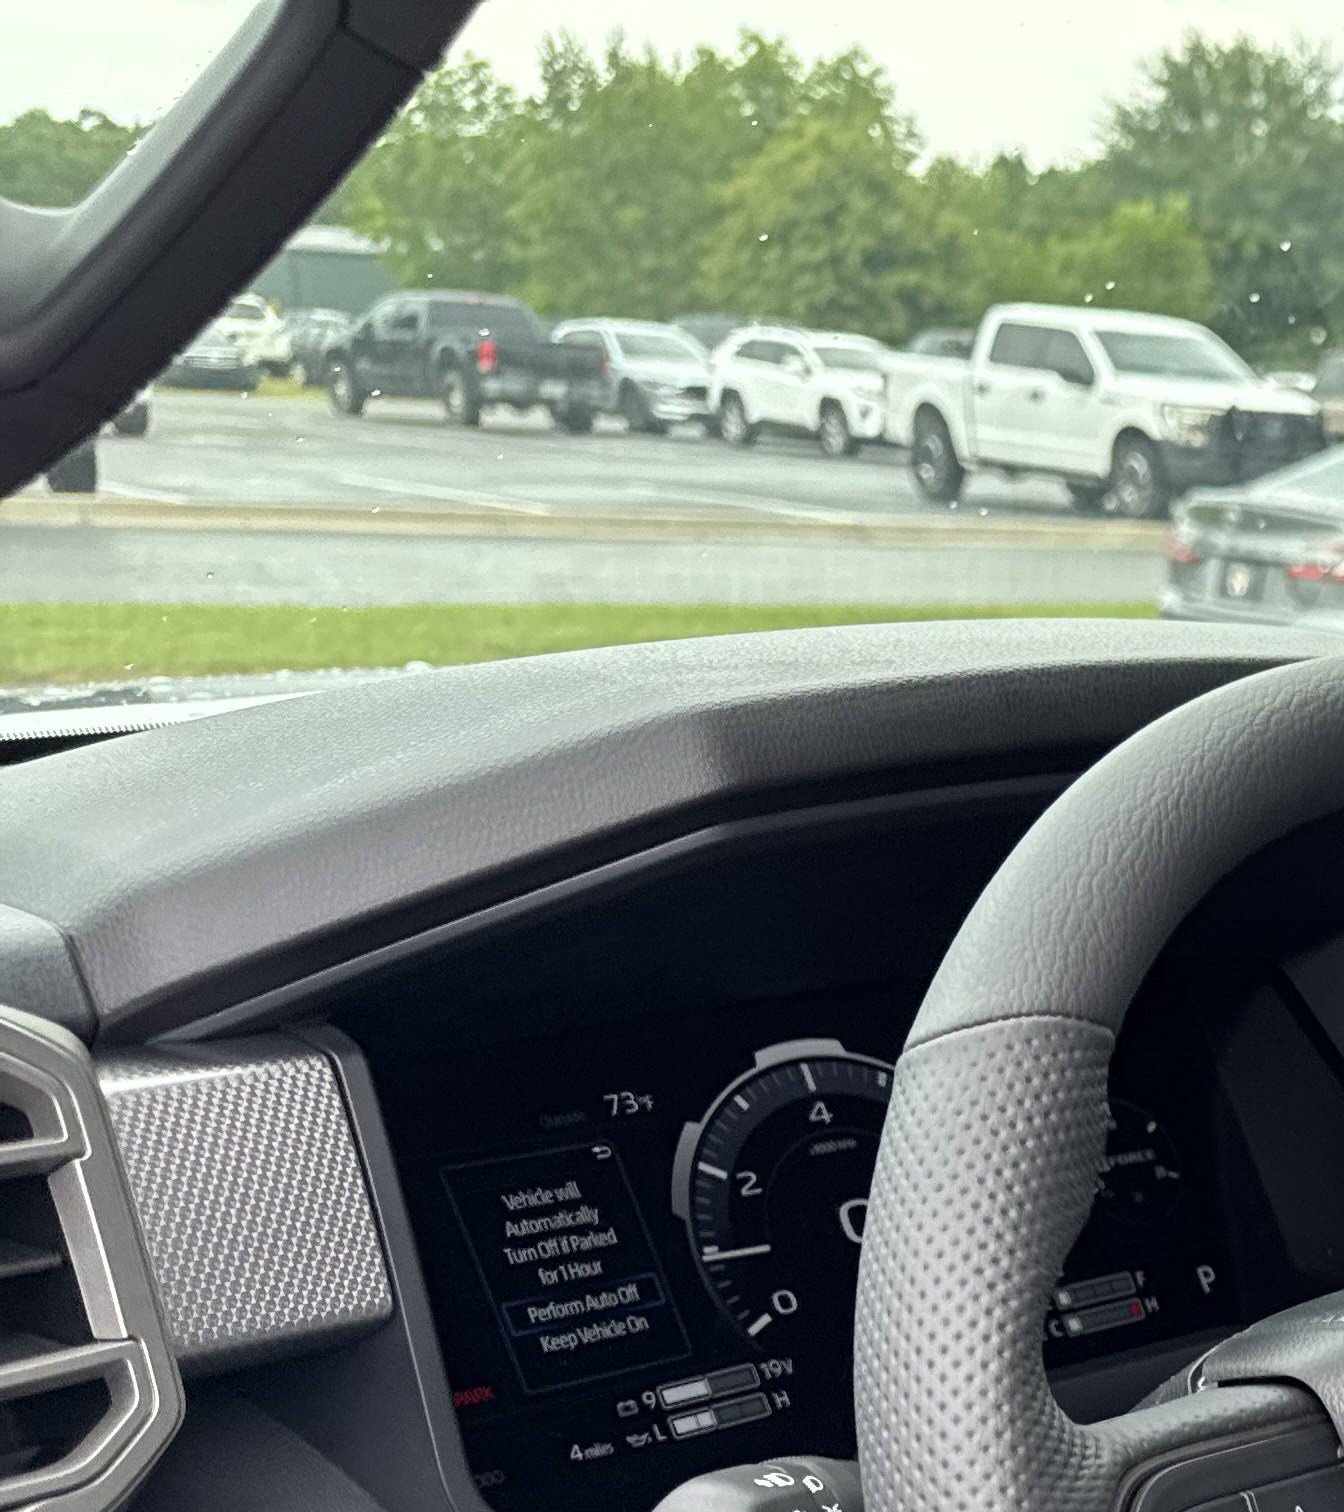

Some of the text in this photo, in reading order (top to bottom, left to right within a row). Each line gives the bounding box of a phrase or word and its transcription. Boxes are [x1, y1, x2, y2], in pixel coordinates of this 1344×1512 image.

[808, 1101, 834, 1125] 4
[501, 1180, 582, 1211] Vehicle will
[736, 1171, 763, 1197] 2
[503, 1204, 600, 1238] Automatically
[503, 1243, 537, 1266] Turn
[536, 1240, 560, 1260] Off
[569, 1226, 618, 1253] Parked
[537, 1267, 559, 1287] for
[569, 1259, 603, 1280] Hour
[1135, 1270, 1146, 1288] F
[1196, 1264, 1216, 1295] P
[526, 1283, 640, 1325] Perform Auto Off
[771, 1289, 798, 1315] 0
[1048, 1295, 1160, 1338] C H
[539, 1314, 649, 1354] Keep Vehicle On
[641, 1357, 793, 1409] 9 19V
[652, 1389, 792, 1442] L H
[569, 1441, 615, 1462] 4 miles
